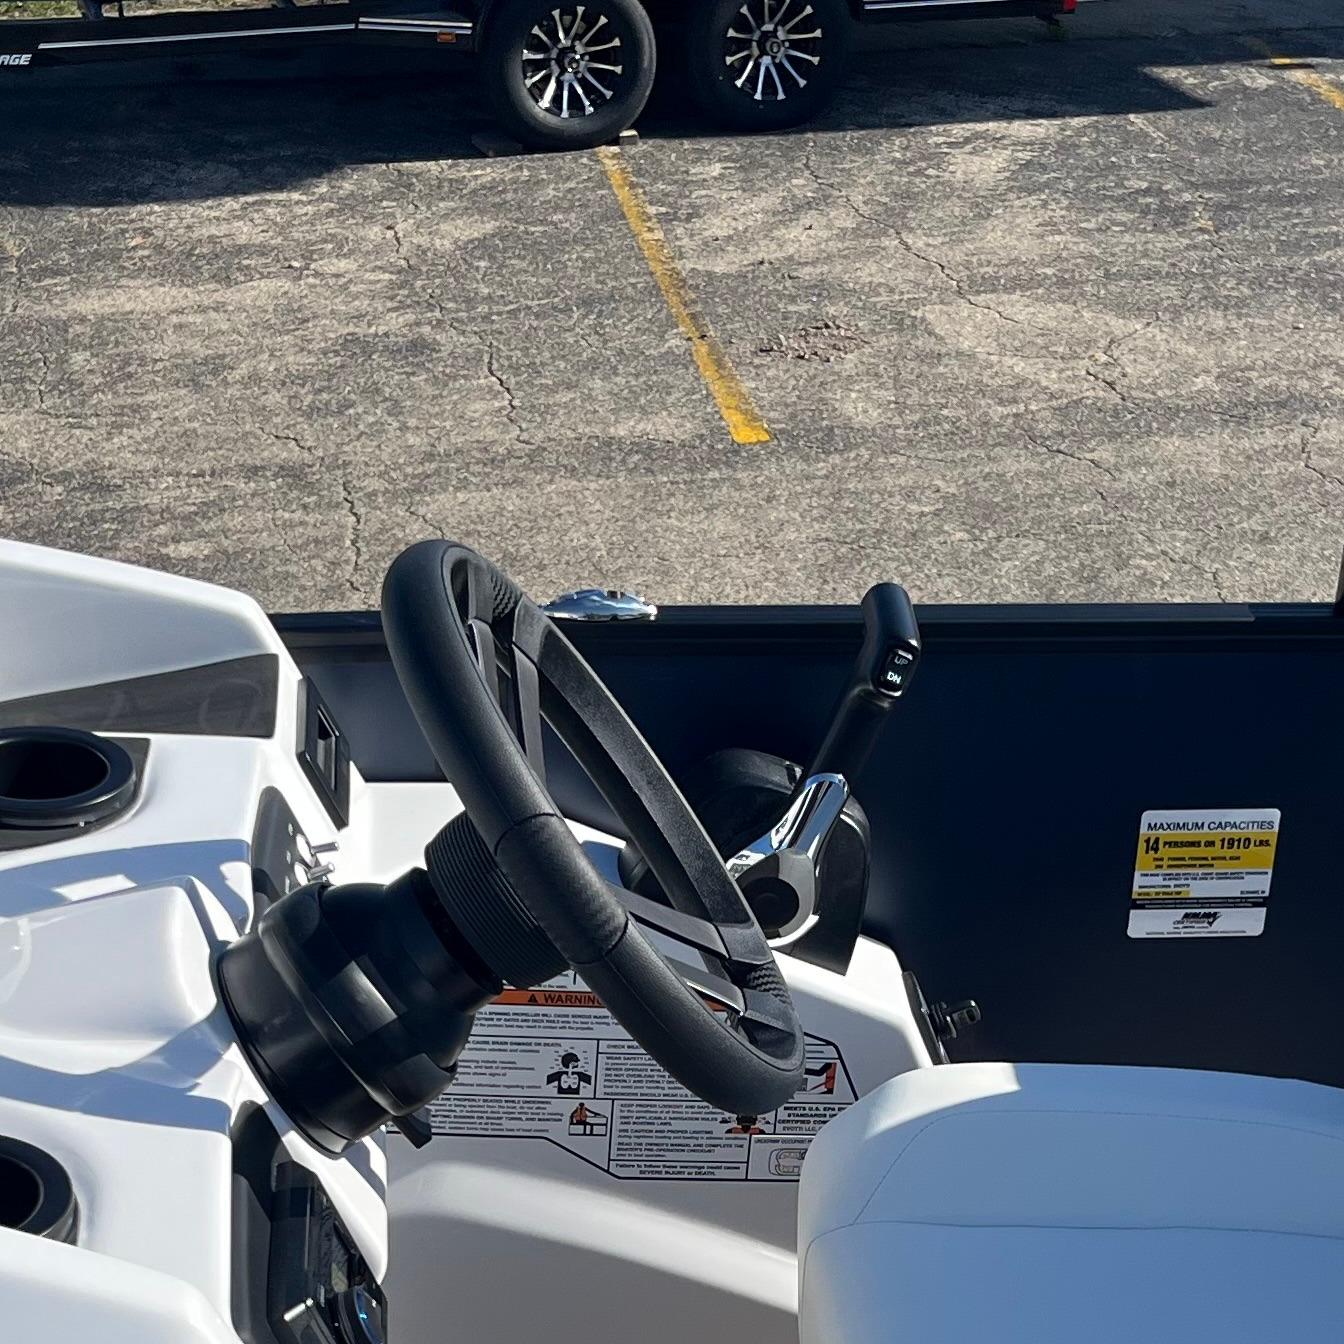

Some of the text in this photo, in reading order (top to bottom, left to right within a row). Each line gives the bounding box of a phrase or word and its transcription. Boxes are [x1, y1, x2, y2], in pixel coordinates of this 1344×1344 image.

[894, 655, 909, 666] UP
[886, 670, 903, 685] DN
[1146, 820, 1275, 833] MAXIMUM CAPACITIES
[1143, 836, 1160, 855] 14
[1162, 839, 1202, 849] PERSONS
[1203, 839, 1216, 849] OR
[1219, 837, 1252, 850] 1910
